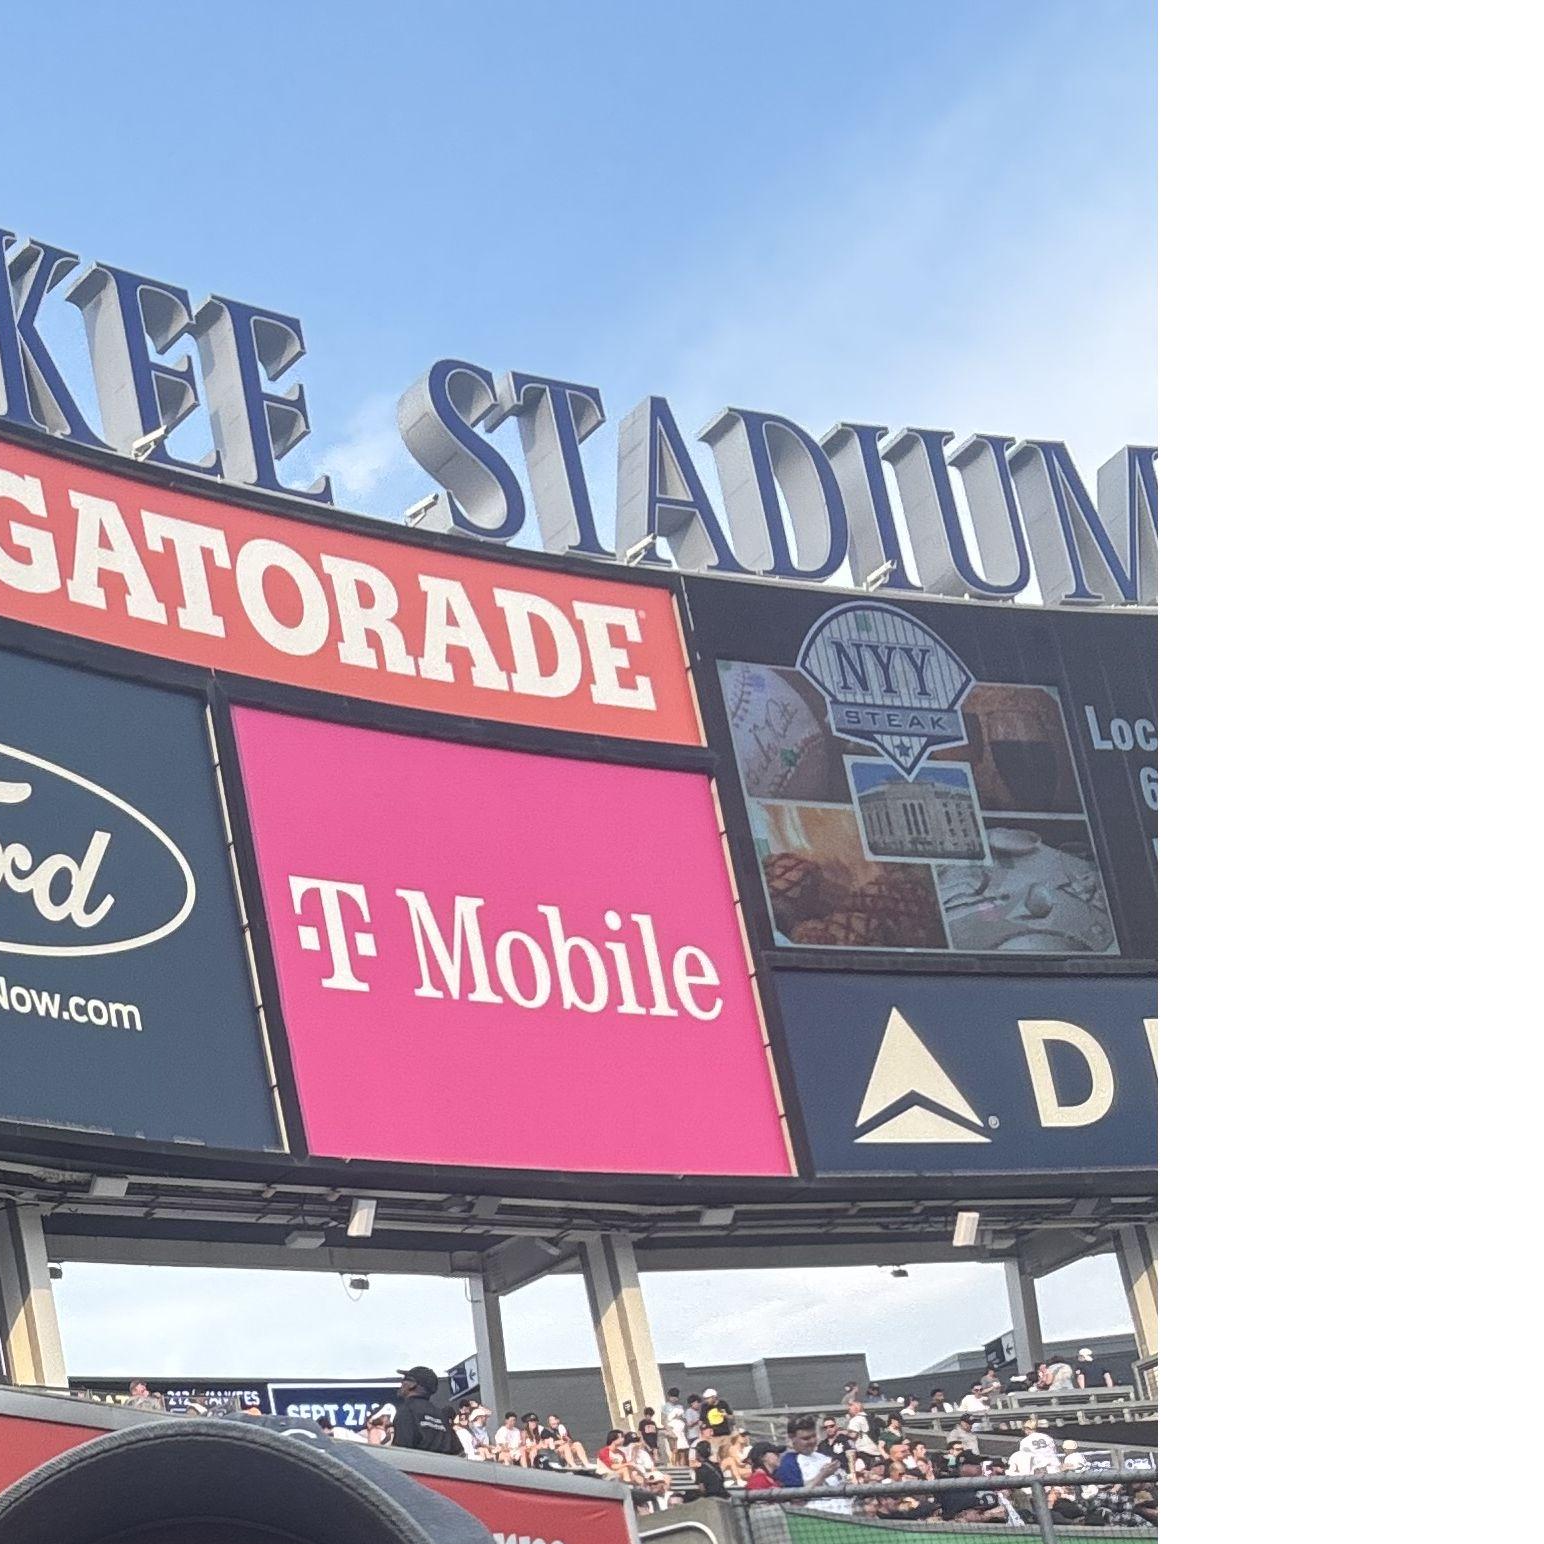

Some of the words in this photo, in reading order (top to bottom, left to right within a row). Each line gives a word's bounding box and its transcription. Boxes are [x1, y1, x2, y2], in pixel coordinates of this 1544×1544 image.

[829, 638, 933, 698] NYY
[844, 709, 947, 732] STEAK
[395, 888, 724, 1022] Mobile
[1018, 1018, 1158, 1128] D
